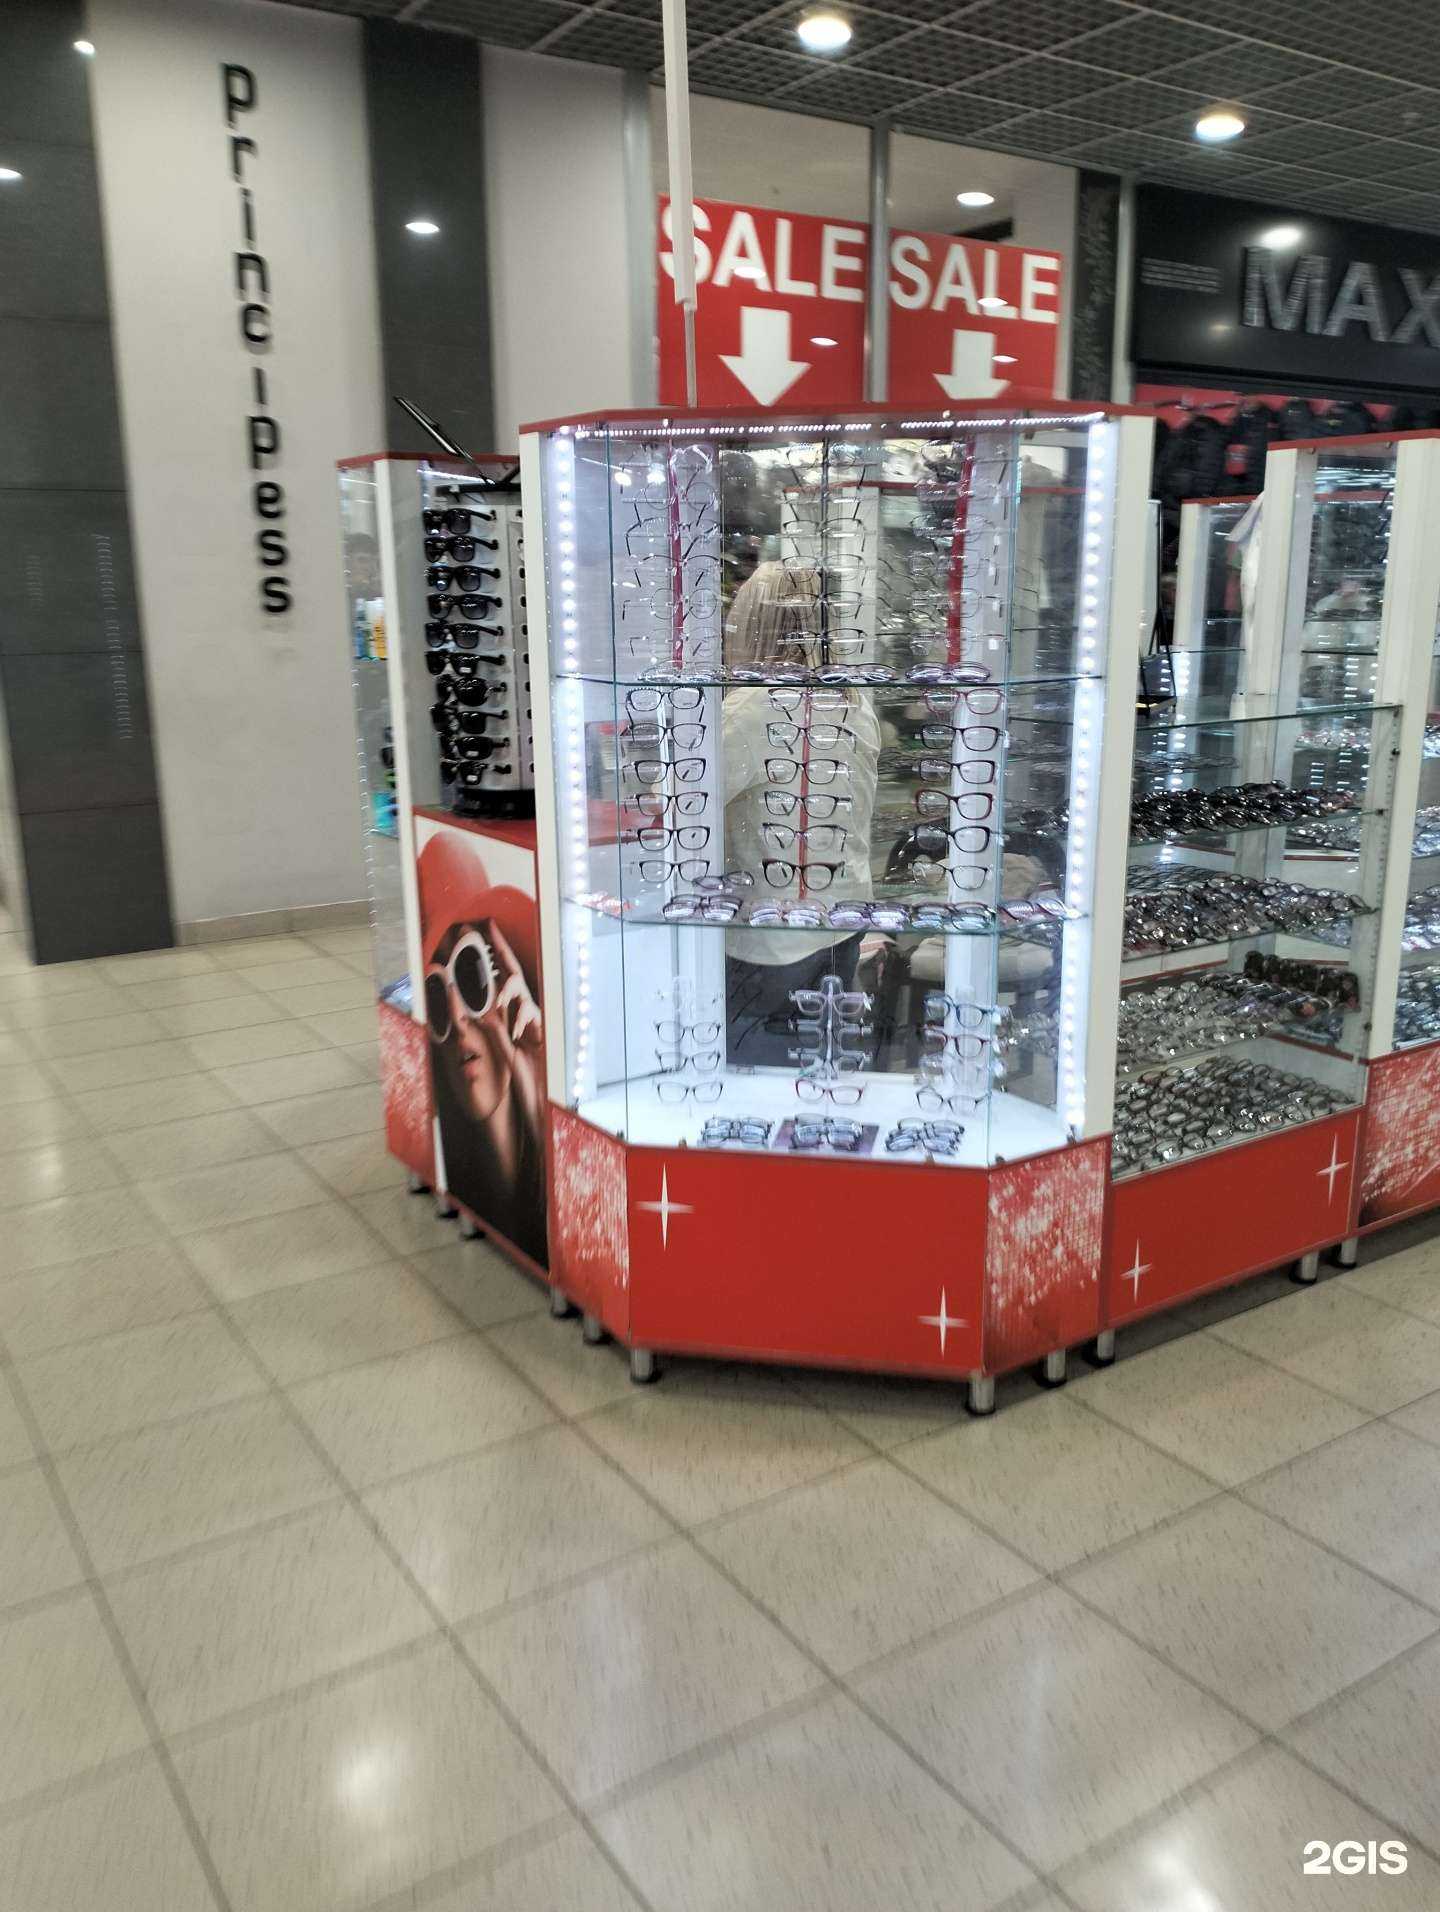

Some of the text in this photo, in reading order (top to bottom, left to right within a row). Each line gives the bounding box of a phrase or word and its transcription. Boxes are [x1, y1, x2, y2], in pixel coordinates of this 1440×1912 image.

[659, 203, 866, 303] SALE
[889, 235, 1059, 324] SALE
[1242, 246, 1440, 348] MAX
[220, 62, 294, 616] principess
